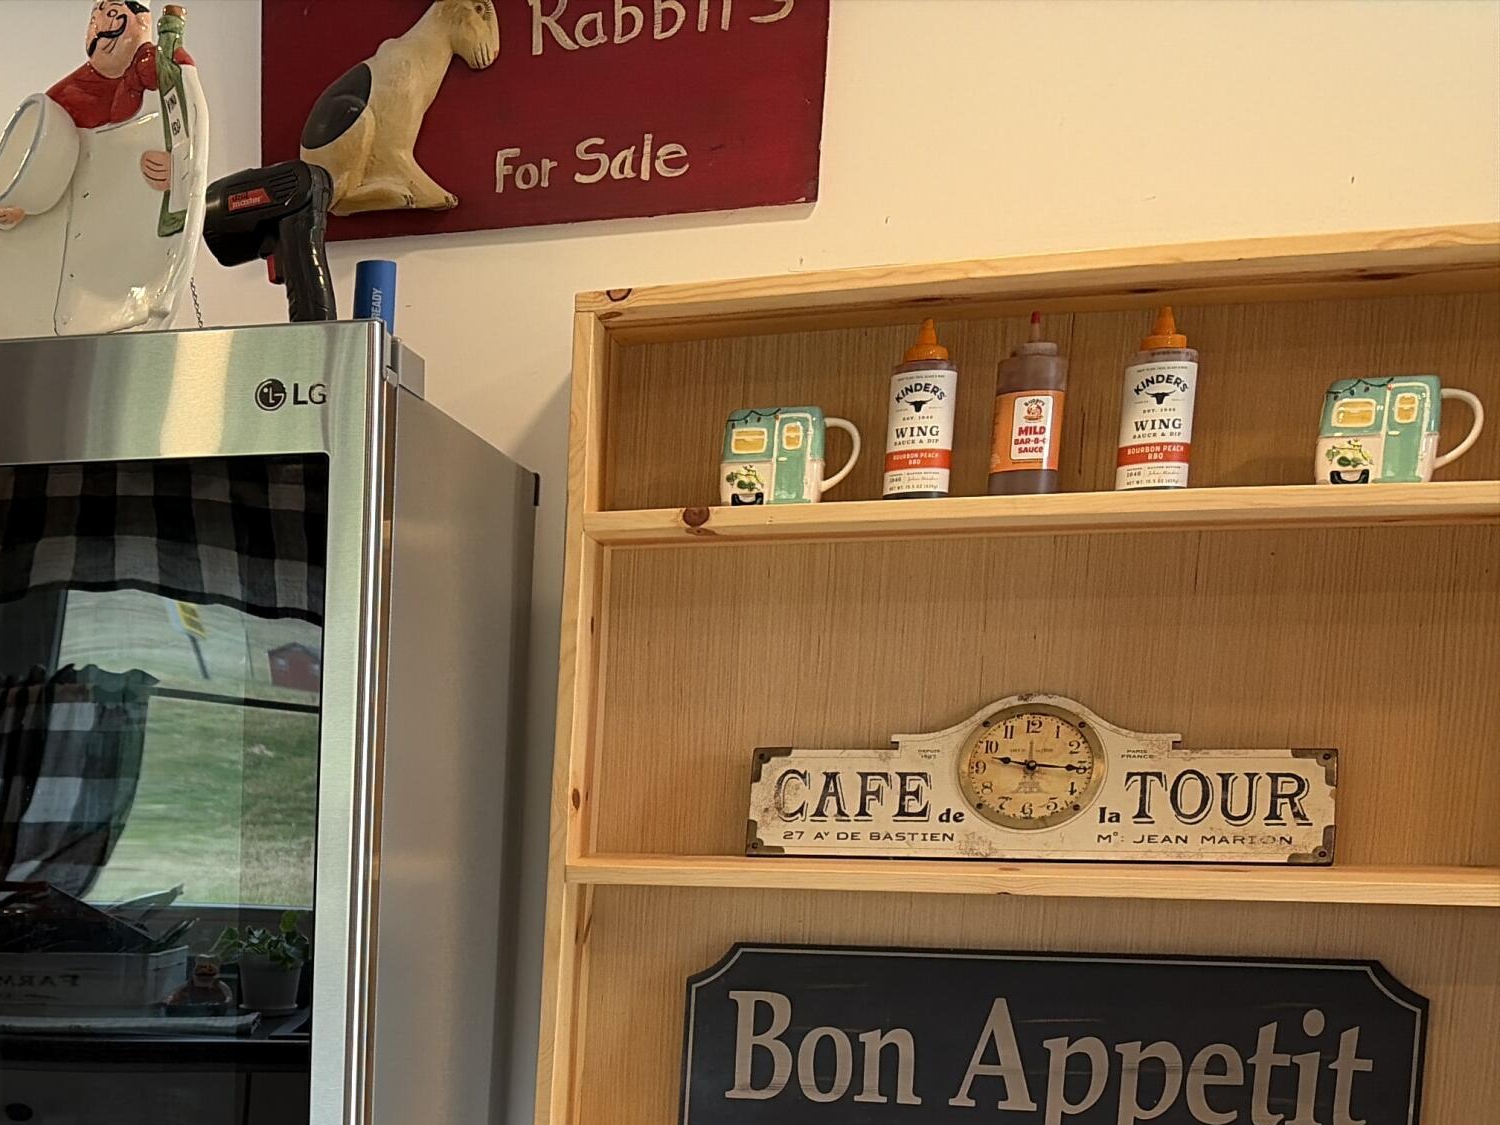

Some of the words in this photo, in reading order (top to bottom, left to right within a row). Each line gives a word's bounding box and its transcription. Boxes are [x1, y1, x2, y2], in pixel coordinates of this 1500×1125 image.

[495, 147, 558, 194] For
[574, 133, 690, 184] Sale
[1133, 373, 1189, 396] KINDER'S
[292, 382, 327, 406] LG
[894, 382, 946, 404] KINDER'S
[894, 425, 940, 439] WING
[1017, 425, 1047, 437] MILD
[1133, 418, 1183, 432] WING
[893, 438, 917, 447] SAUCE
[1132, 432, 1158, 440] SAUCE
[892, 452, 919, 461] BOURBON
[1127, 445, 1161, 456] BOURBON
[1162, 444, 1185, 453] PEACH
[1003, 725, 1015, 740] 11
[1026, 719, 1043, 734] 12
[1054, 725, 1062, 739] 1
[984, 740, 1000, 754] 10
[1068, 740, 1082, 755] 2
[974, 761, 987, 775] 9
[981, 782, 994, 795] 8
[774, 768, 933, 823] CAFE
[937, 807, 966, 824] de
[1098, 806, 1121, 824] la
[1124, 768, 1314, 828] TOUR
[782, 830, 805, 841] 27
[836, 831, 862, 842] DE
[869, 831, 956, 842] BASTIEN
[1132, 834, 1189, 845] JEAN
[1200, 834, 1294, 846] MARION
[723, 988, 923, 1107] Bon
